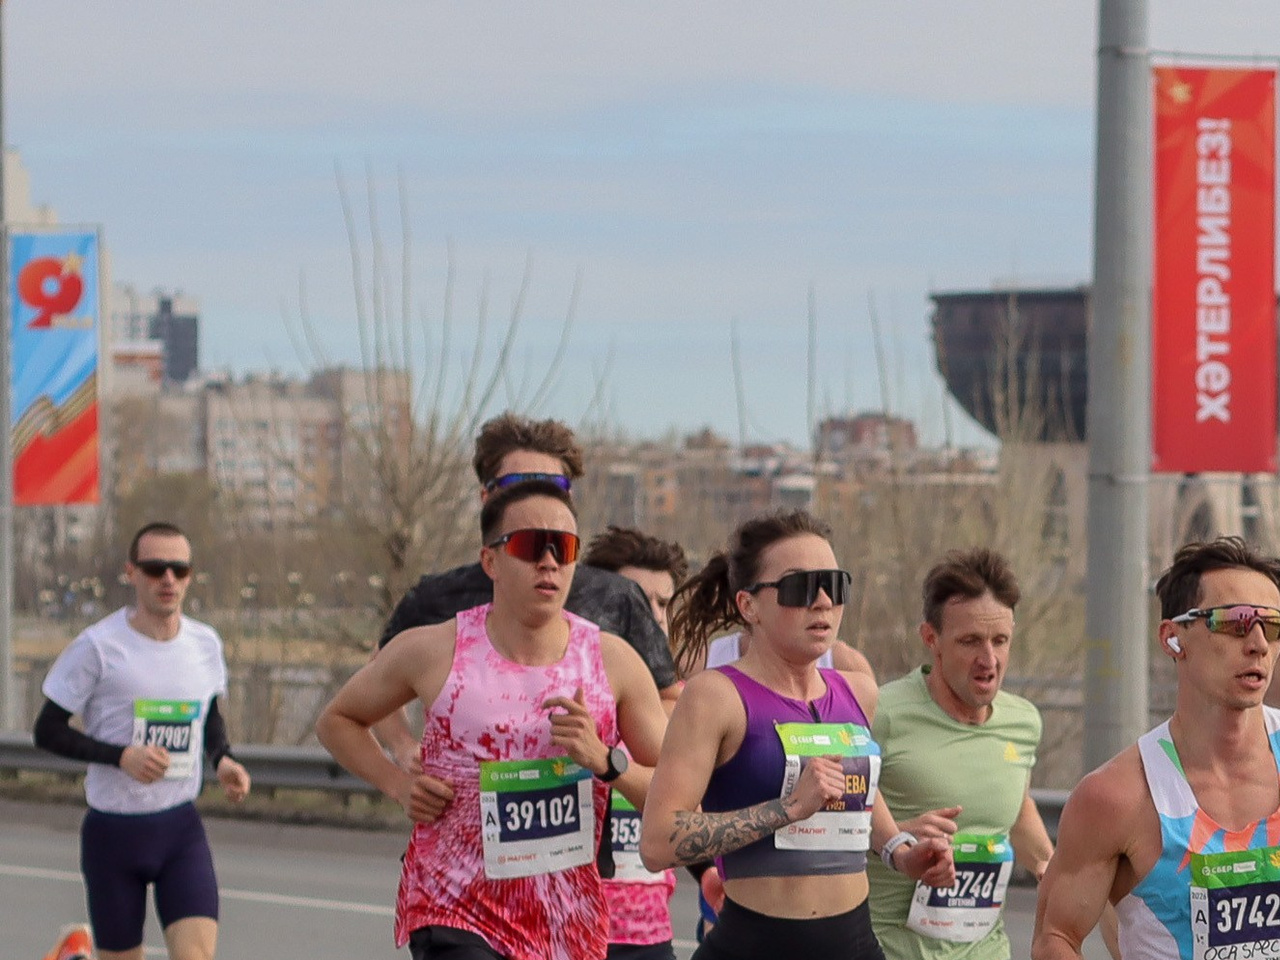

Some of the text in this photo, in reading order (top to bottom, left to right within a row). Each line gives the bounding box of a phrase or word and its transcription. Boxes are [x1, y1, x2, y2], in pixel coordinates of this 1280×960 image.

[1196, 117, 1232, 423] ХӘТЕРЛИБЕЗ!
[505, 794, 576, 831] 39102
[1211, 865, 1232, 874] СБЕР
[1195, 910, 1207, 924] A
